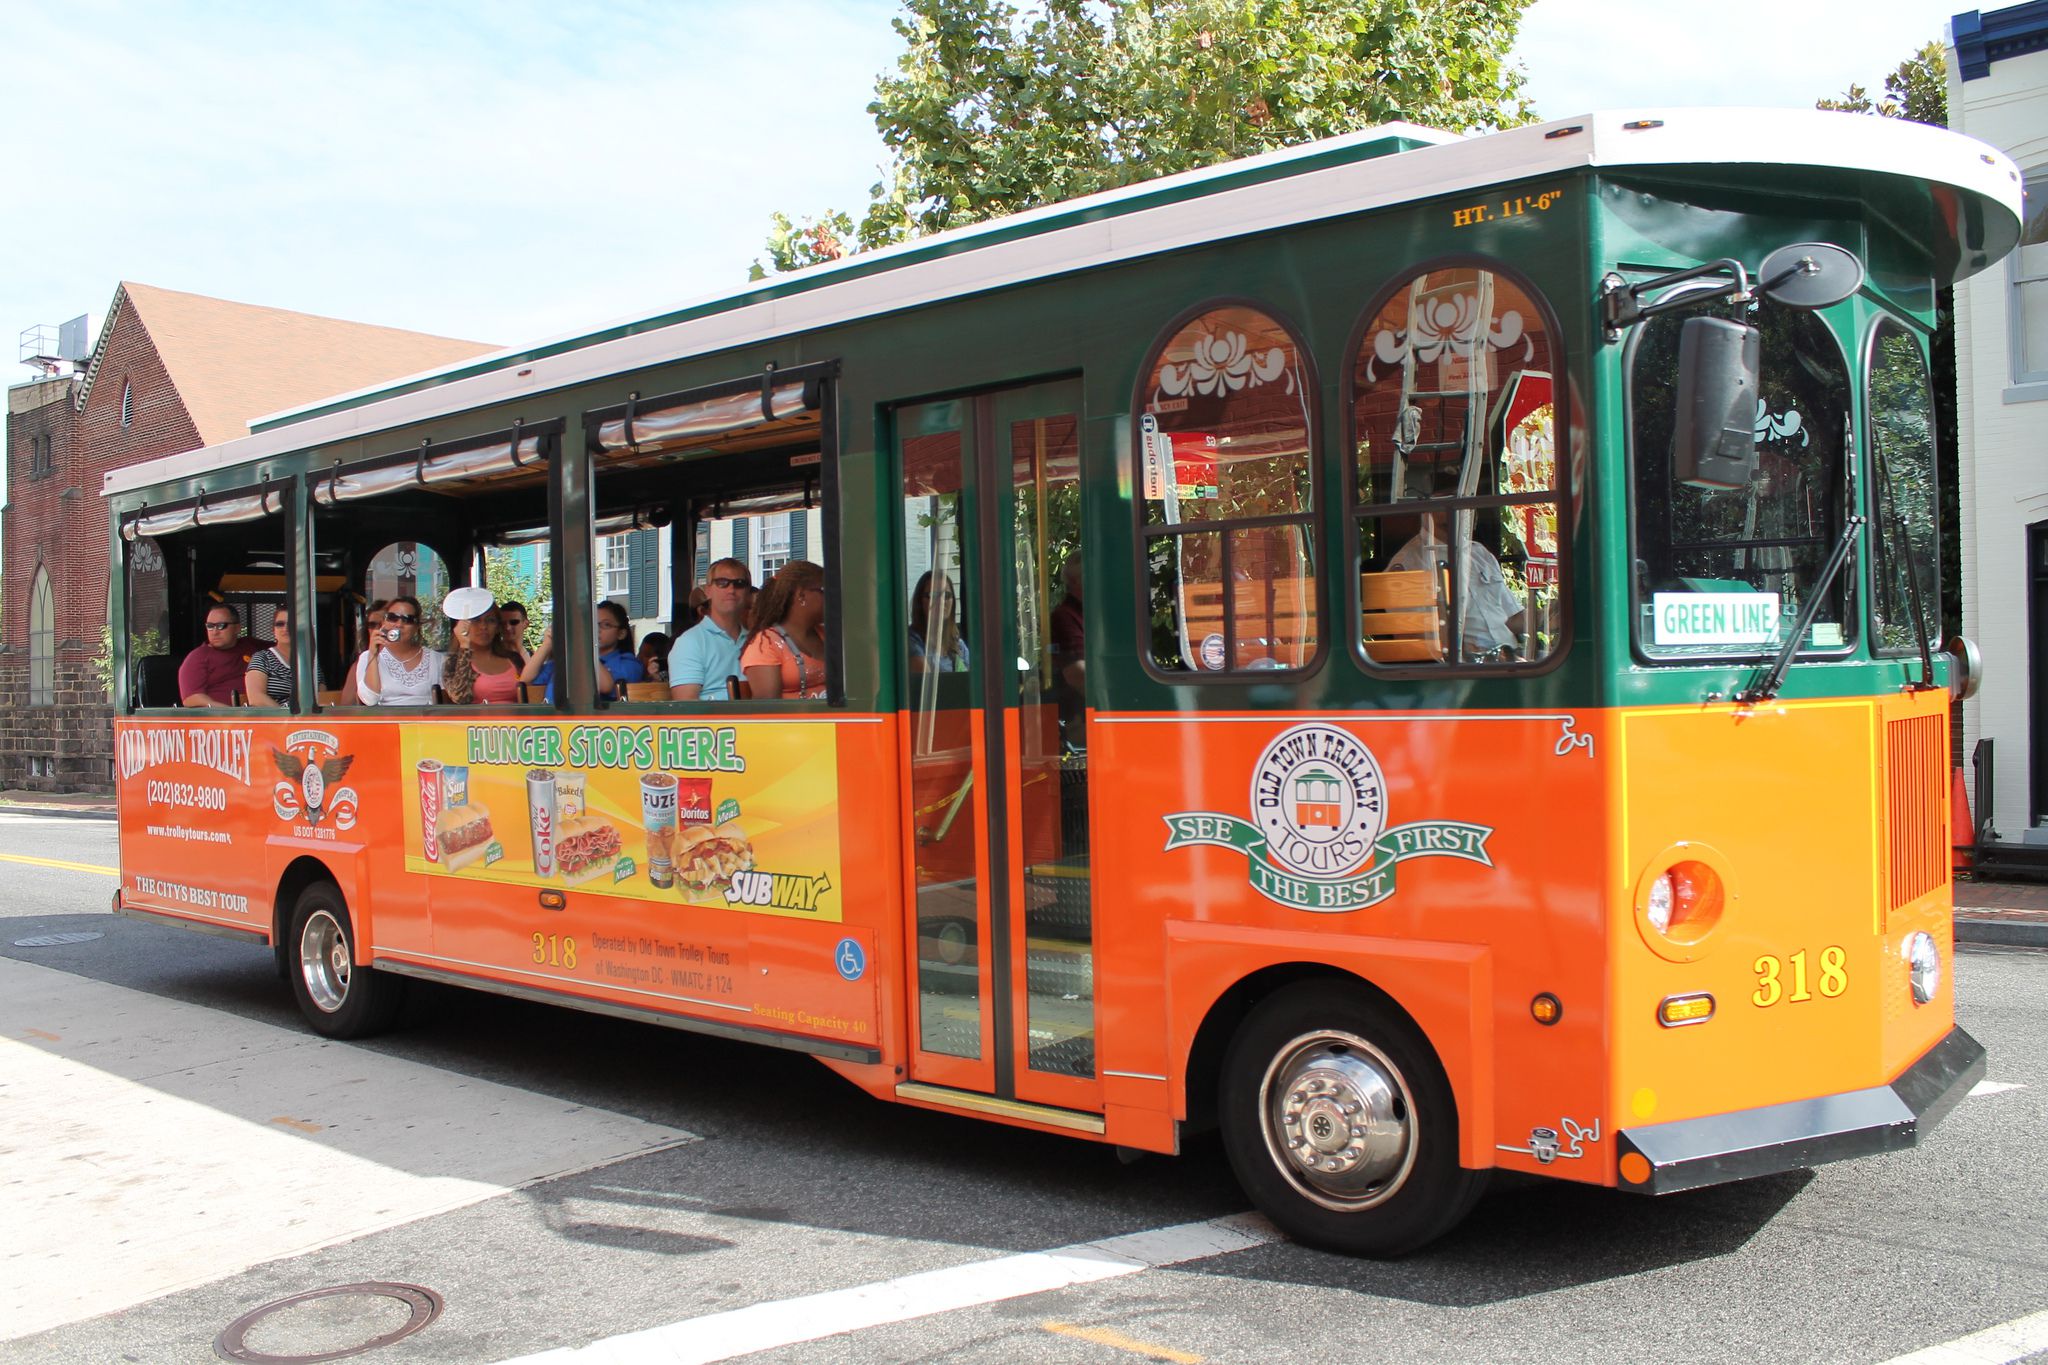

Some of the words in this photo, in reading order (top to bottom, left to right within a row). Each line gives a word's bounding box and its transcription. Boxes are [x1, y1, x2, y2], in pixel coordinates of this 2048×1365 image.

[1452, 204, 1495, 228] HT.
[1502, 190, 1562, 219] 11'-6"
[1663, 603, 1727, 634] GREEN
[1732, 603, 1773, 634] LINE
[119, 730, 146, 780] OLD
[147, 729, 186, 767] TOWN
[188, 729, 253, 787] TROLLEY
[467, 725, 566, 767] HUNGER
[568, 725, 654, 771] STOPS
[658, 726, 746, 774] HERE.
[1270, 733, 1318, 773] TOWN
[1259, 771, 1282, 808] OLD
[1323, 734, 1379, 813] TROLLEY
[147, 779, 227, 811] (202)832-9800
[643, 792, 676, 809] FUZE
[680, 807, 710, 820] Doritos
[537, 807, 552, 873] Coke
[1278, 826, 1363, 870] TOURS
[1177, 817, 1234, 842] SEE
[1255, 865, 1310, 905] THE
[1317, 872, 1387, 907] BEST
[1393, 827, 1481, 854] FIRST
[135, 876, 156, 895] THE
[156, 880, 188, 902] CITY'S
[188, 887, 219, 908] BEST
[218, 893, 249, 914] TOUR
[723, 869, 832, 912] SUBWAY
[532, 931, 578, 970] 318
[592, 932, 625, 952] Operated
[626, 938, 638, 955] by
[639, 938, 652, 955] Old
[654, 940, 676, 958] Town
[677, 942, 704, 963] Trolley
[707, 945, 730, 966] Tours
[595, 961, 605, 976] of
[605, 960, 650, 984] Washington
[651, 967, 664, 984] DC
[670, 968, 704, 990] WMATC
[706, 975, 713, 992] #
[715, 976, 733, 993] 124
[1752, 945, 1849, 1008] 318
[753, 1003, 795, 1024] Seating
[797, 1010, 849, 1034] Capacity
[852, 1021, 867, 1034] 40
